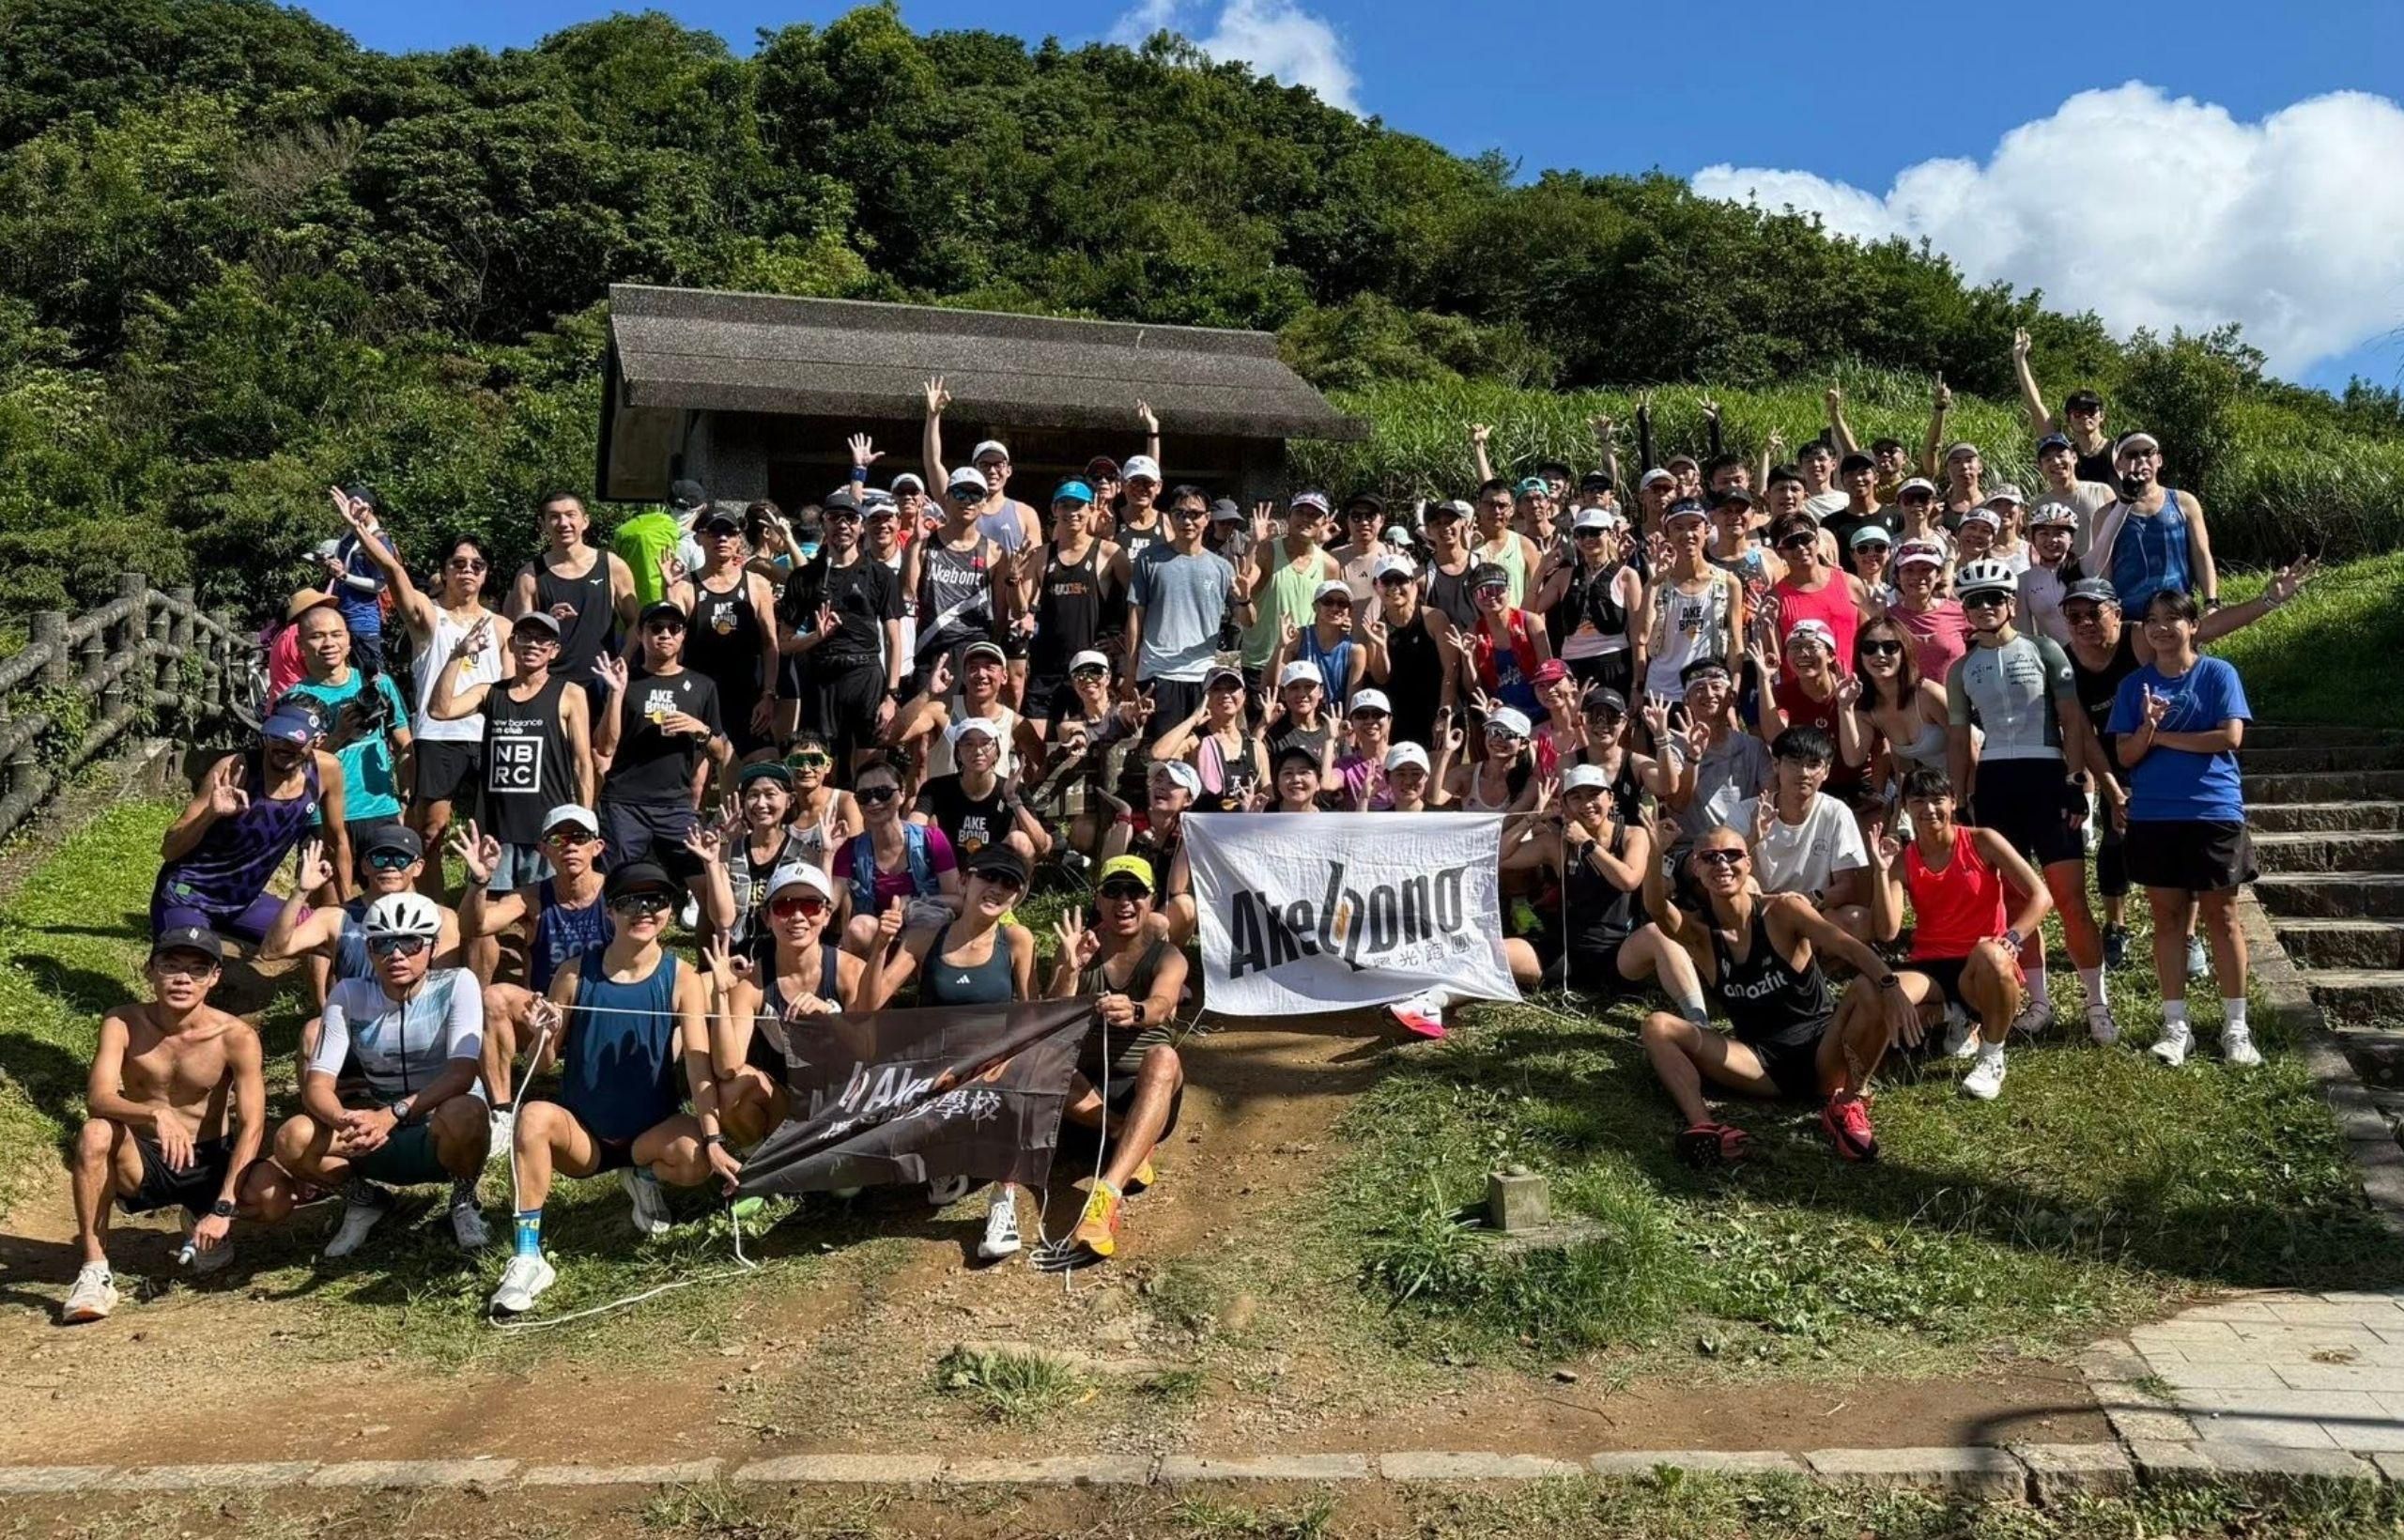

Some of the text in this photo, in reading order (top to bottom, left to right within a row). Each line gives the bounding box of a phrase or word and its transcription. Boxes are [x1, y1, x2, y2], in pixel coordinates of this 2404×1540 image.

[649, 689, 674, 703] AKE
[496, 745, 533, 762] NB
[494, 765, 532, 785] RC
[963, 815, 987, 830] AKE
